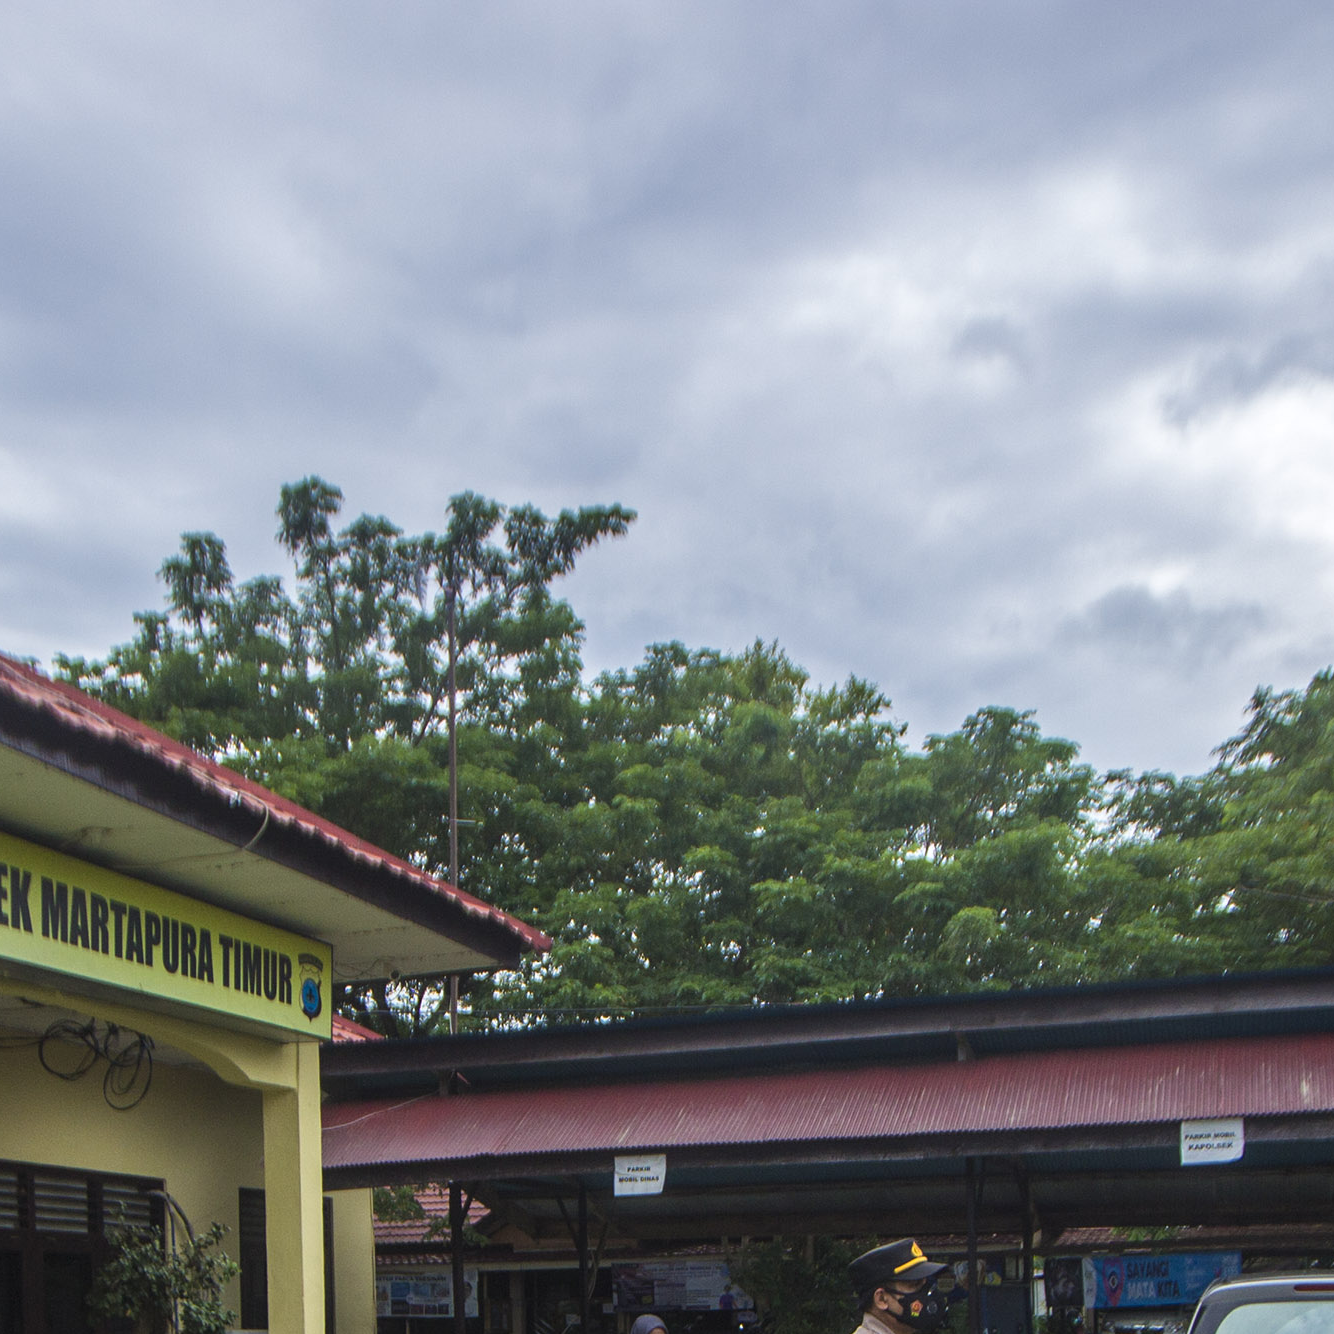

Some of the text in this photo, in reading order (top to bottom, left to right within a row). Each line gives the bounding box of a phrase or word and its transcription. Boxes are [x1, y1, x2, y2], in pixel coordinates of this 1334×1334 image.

[41, 876, 214, 983] MARTAPURA
[219, 934, 293, 1006] TIMUR
[1185, 1130, 1235, 1140] PARKIR MOBIL
[1188, 1141, 1234, 1151] KAPOLSEK
[1127, 1279, 1181, 1299] MATA KITA
